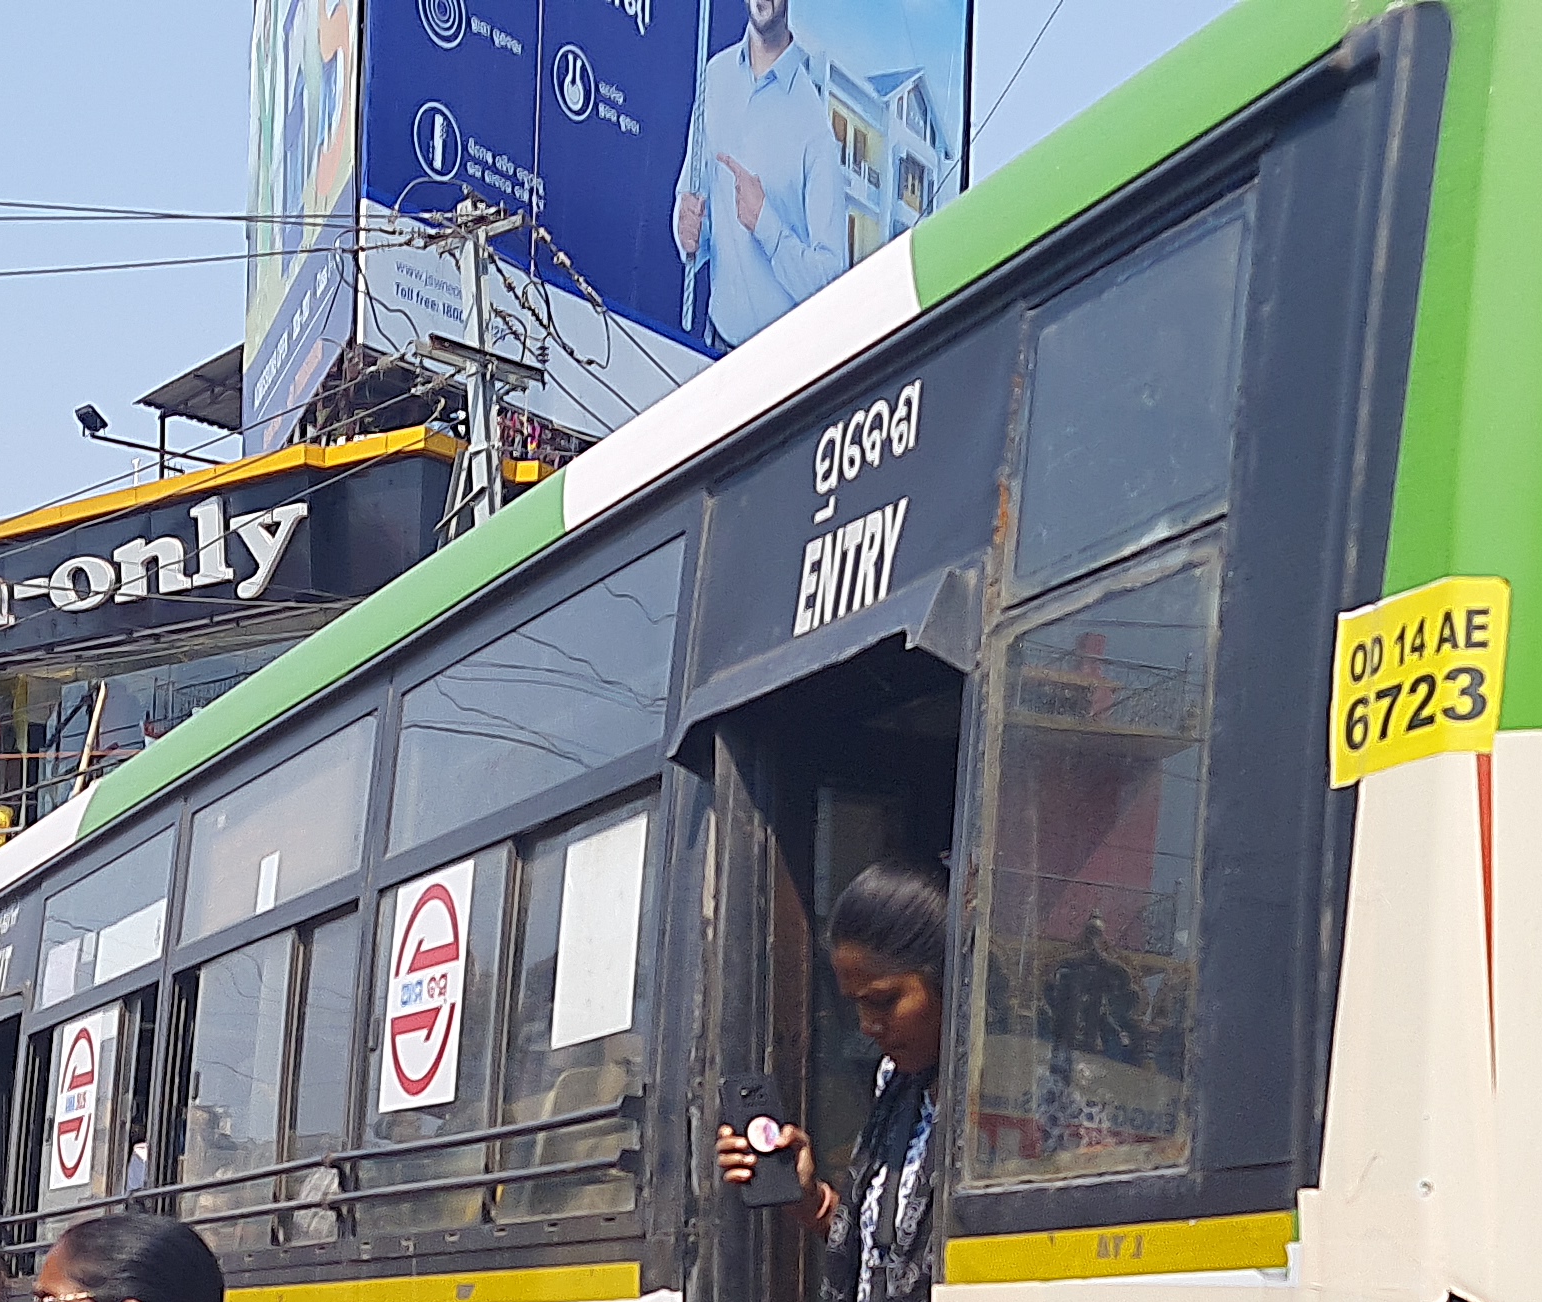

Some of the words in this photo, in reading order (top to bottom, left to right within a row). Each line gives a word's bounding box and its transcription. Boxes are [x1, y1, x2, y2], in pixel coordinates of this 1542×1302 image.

[394, 281, 414, 302] Toll
[812, 377, 924, 525] ପ୍ରବେଶ
[793, 495, 909, 639] ENTRY
[1350, 635, 1384, 684] OD
[1345, 666, 1487, 751] 6723
